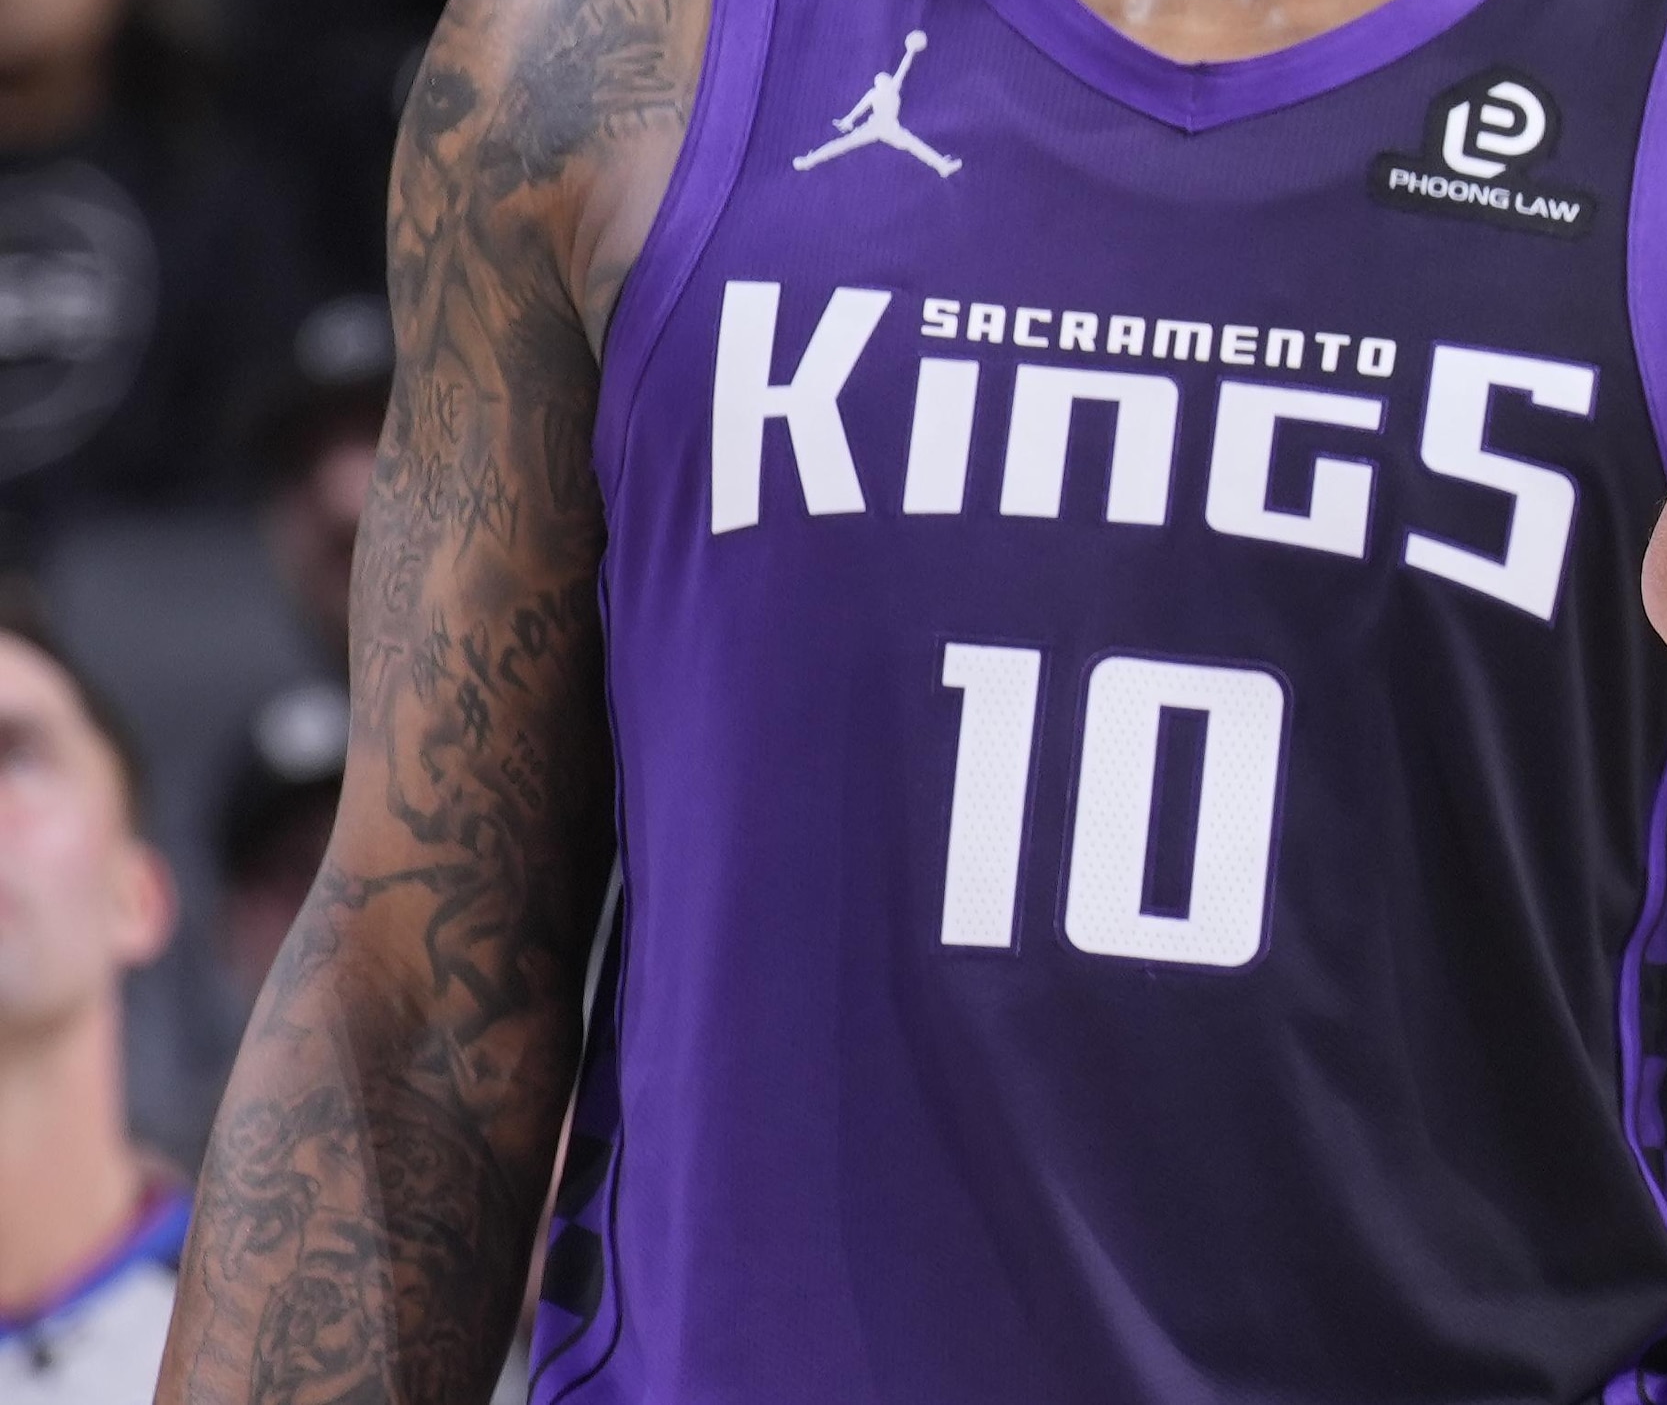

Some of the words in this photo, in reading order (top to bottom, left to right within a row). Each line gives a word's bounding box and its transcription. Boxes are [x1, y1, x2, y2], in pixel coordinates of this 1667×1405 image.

[1389, 168, 1510, 210] PHOONG
[1515, 192, 1580, 223] LAW
[920, 297, 1397, 378] SACRAMENTO
[941, 642, 1284, 967] 10
